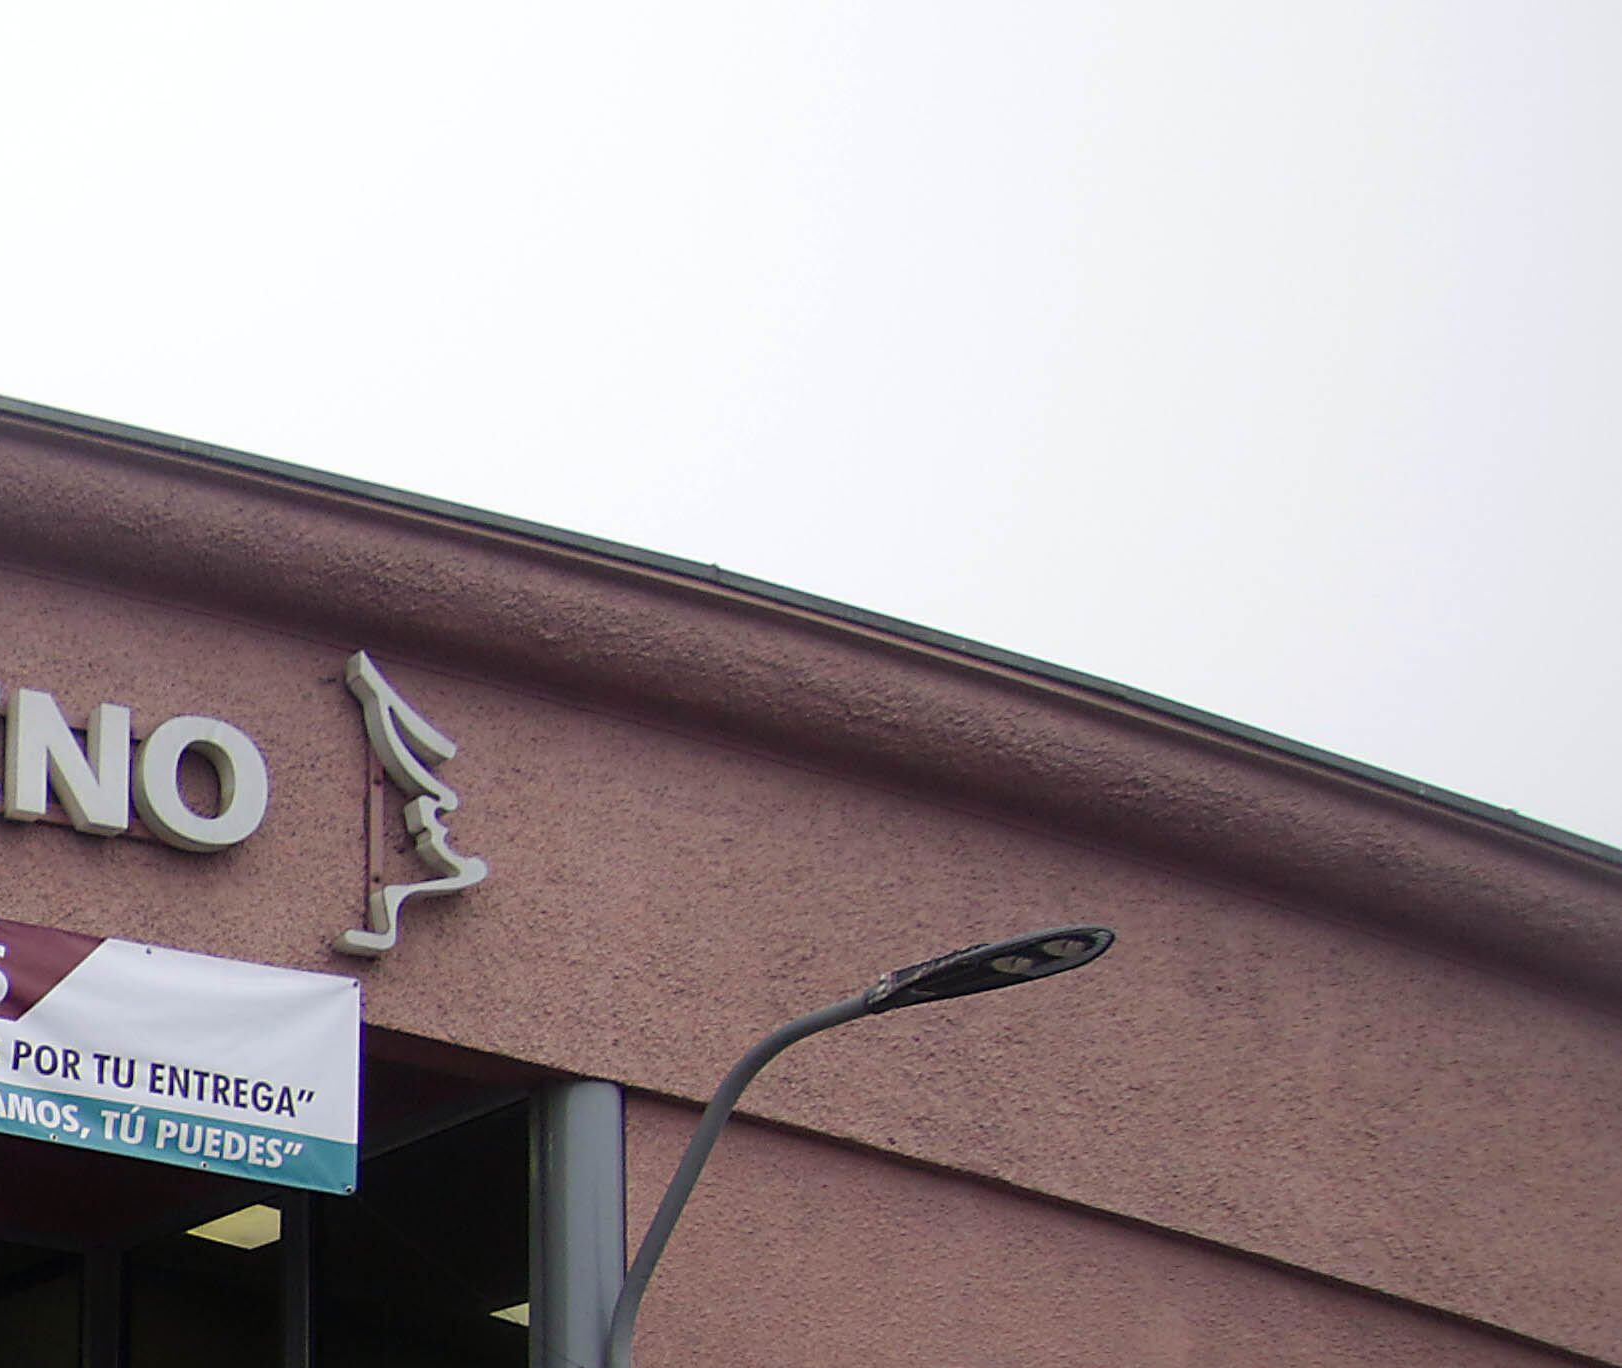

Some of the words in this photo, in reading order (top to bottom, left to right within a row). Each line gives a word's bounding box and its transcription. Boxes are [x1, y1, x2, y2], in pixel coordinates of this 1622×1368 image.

[11, 1040, 81, 1081] POR
[93, 1052, 136, 1089] TU
[148, 1062, 315, 1118] ENTREGA"
[101, 1106, 146, 1146] TÚ
[156, 1118, 304, 1169] PUEDES"
